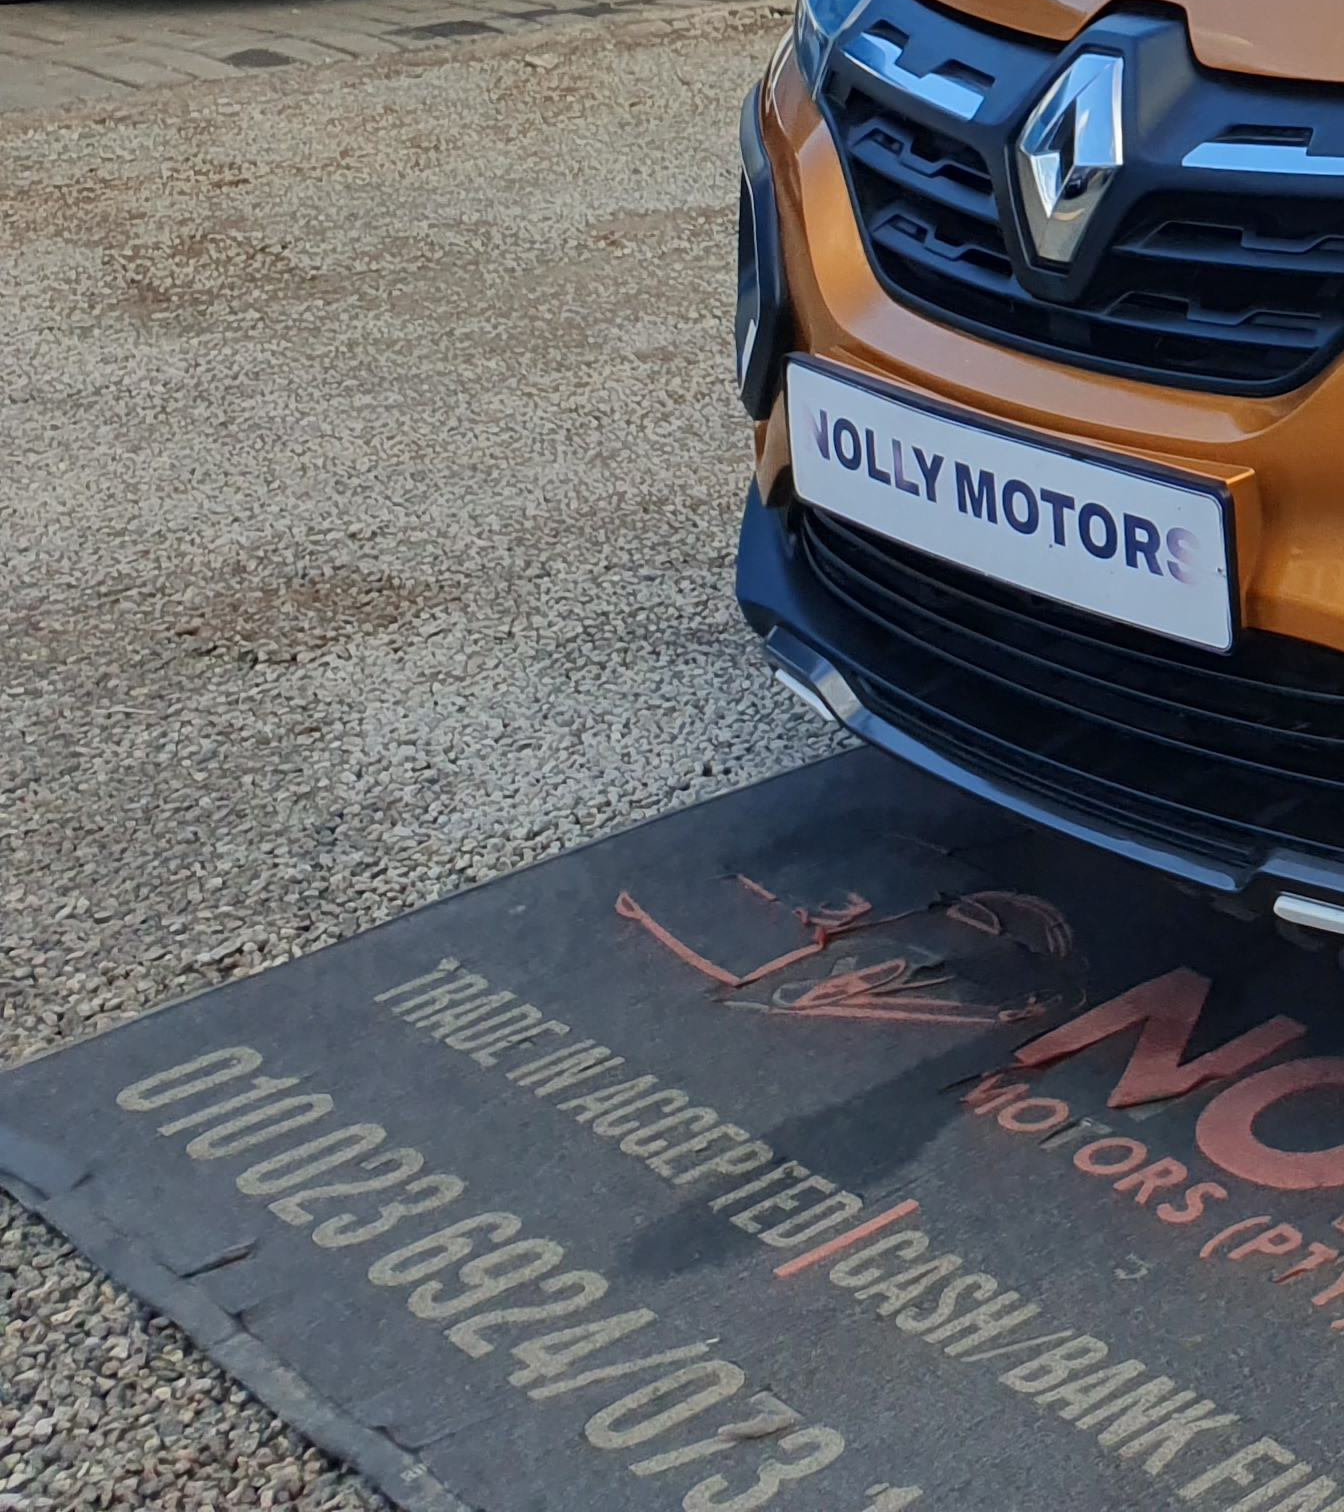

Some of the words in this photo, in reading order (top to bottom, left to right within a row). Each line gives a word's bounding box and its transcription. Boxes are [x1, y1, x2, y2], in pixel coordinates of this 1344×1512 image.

[954, 459, 1201, 586] MOTORS
[374, 955, 571, 1067] TRADE
[505, 1038, 626, 1096] IN
[959, 1071, 1229, 1225] MOTORS
